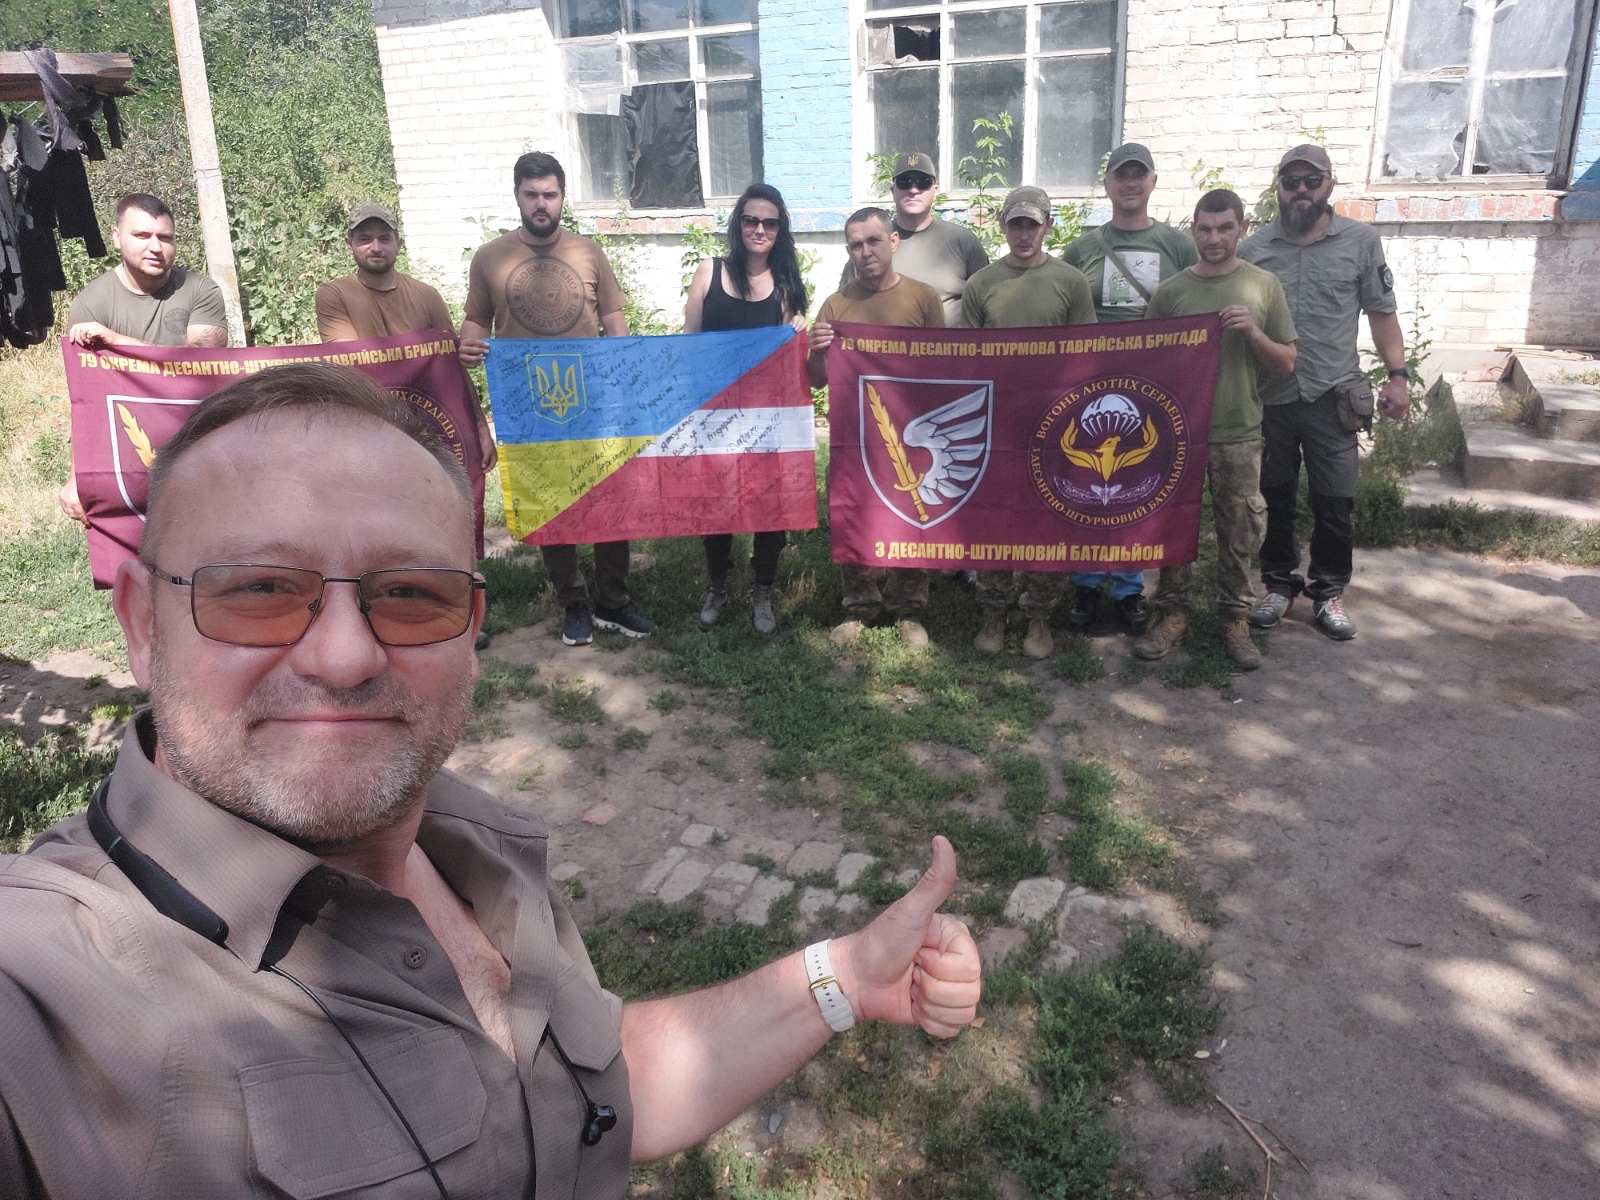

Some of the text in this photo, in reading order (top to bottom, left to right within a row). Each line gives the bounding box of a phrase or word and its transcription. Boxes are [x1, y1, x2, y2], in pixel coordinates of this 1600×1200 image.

[78, 352, 98, 368] 79
[100, 355, 161, 375] ОКРЕМА
[404, 339, 457, 357] БРИГАДА
[857, 338, 907, 354] ОКРЕМА
[909, 340, 1056, 357] ДЕСАНТНО-ШТУРМОВА
[1058, 335, 1143, 354] ТАВРІЙСЬКА
[1145, 329, 1208, 349] БРИГАДА
[1036, 378, 1185, 439] ВОГОНЬ ЛЮТИХ СЕРДЕЦЬ
[875, 541, 1164, 561] 3 ДЕСАНТНО-ШТУРМОВИЙ БАТАЛЬЙОН
